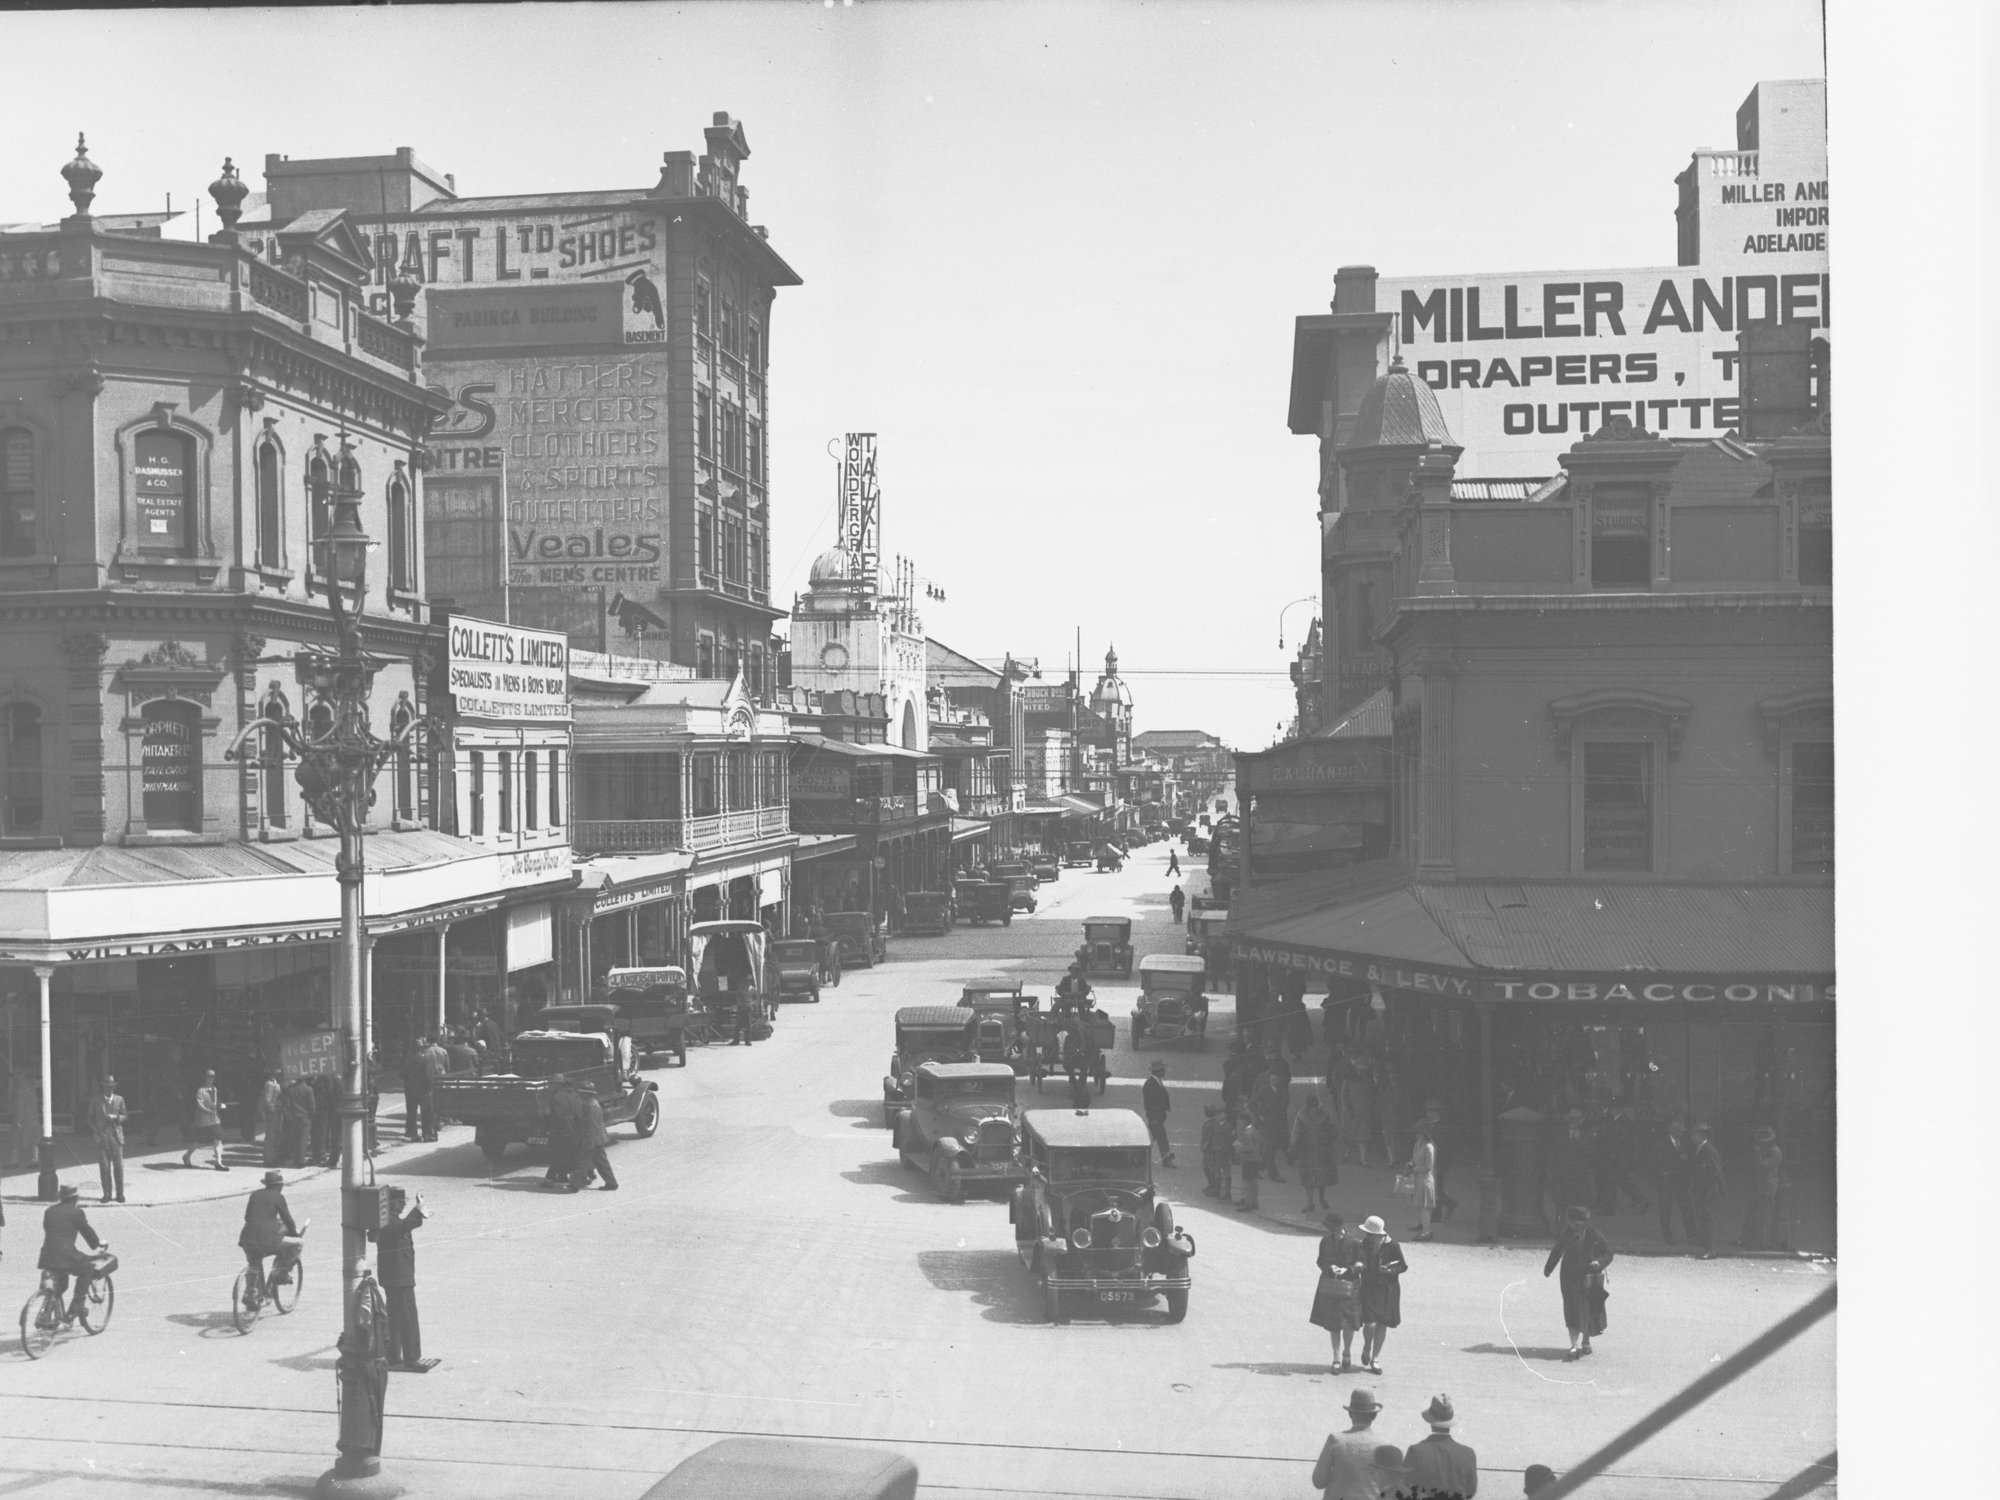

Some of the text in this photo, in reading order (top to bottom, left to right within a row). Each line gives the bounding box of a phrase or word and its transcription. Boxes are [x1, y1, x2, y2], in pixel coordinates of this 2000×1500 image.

[1722, 183, 1785, 204] MILLER
[559, 219, 657, 268] SHOES
[1743, 232, 1826, 254] ADELAIDE
[530, 305, 598, 325] BUILDING
[1401, 281, 1627, 345] MILLER
[625, 330, 666, 342] BASEMENT
[509, 364, 658, 393] HATTERS
[509, 396, 658, 425] MERCERS
[1504, 397, 1739, 436] OUTFITTE
[509, 429, 659, 458] CLOTHIERS
[135, 467, 183, 476] RASMUSSEN
[521, 464, 658, 492] & SPORTS
[145, 508, 175, 517] AGENTS
[509, 497, 660, 523] OUTFITTERS
[510, 526, 662, 563] Veales
[540, 564, 585, 583] MEN'S
[592, 566, 660, 583] CENTRE
[452, 625, 514, 664] COLLETT'S
[450, 667, 492, 690] SPECIALISTS
[524, 703, 569, 717] LIMITED
[641, 884, 673, 898] LIMITED
[67, 939, 228, 961] WILLIAMS
[1236, 944, 1353, 976] LAWRENCE
[1367, 964, 1380, 981] &
[299, 1055, 337, 1076] LEFT
